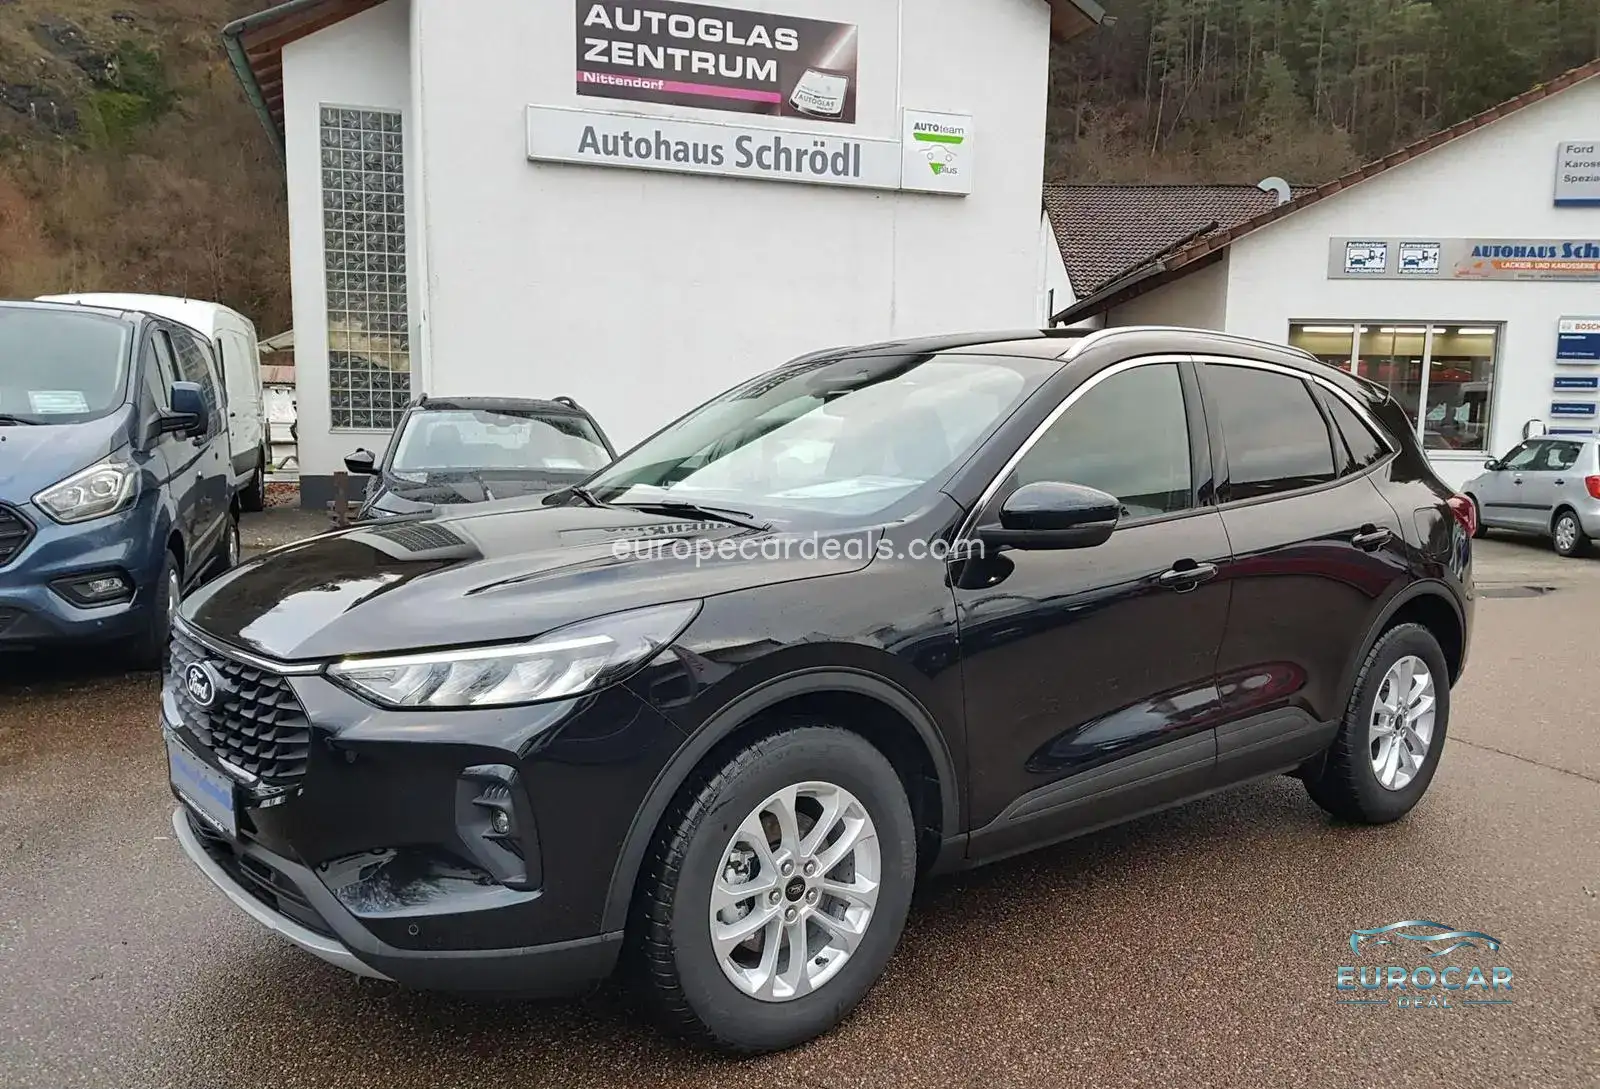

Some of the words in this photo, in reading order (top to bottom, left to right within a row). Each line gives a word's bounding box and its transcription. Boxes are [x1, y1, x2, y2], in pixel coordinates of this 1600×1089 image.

[583, 4, 799, 51] AUTOGLAS
[584, 37, 777, 82] ZENTRUM
[583, 71, 664, 90] Nittendorf
[798, 94, 835, 107] AUTOGLAS
[913, 122, 964, 135] AUTOteam
[578, 125, 724, 166] Autohaus
[735, 135, 860, 177] Schrödl
[1566, 145, 1594, 154] Ford
[1471, 245, 1556, 258] AUTOHAUS
[188, 668, 209, 700] Ford
